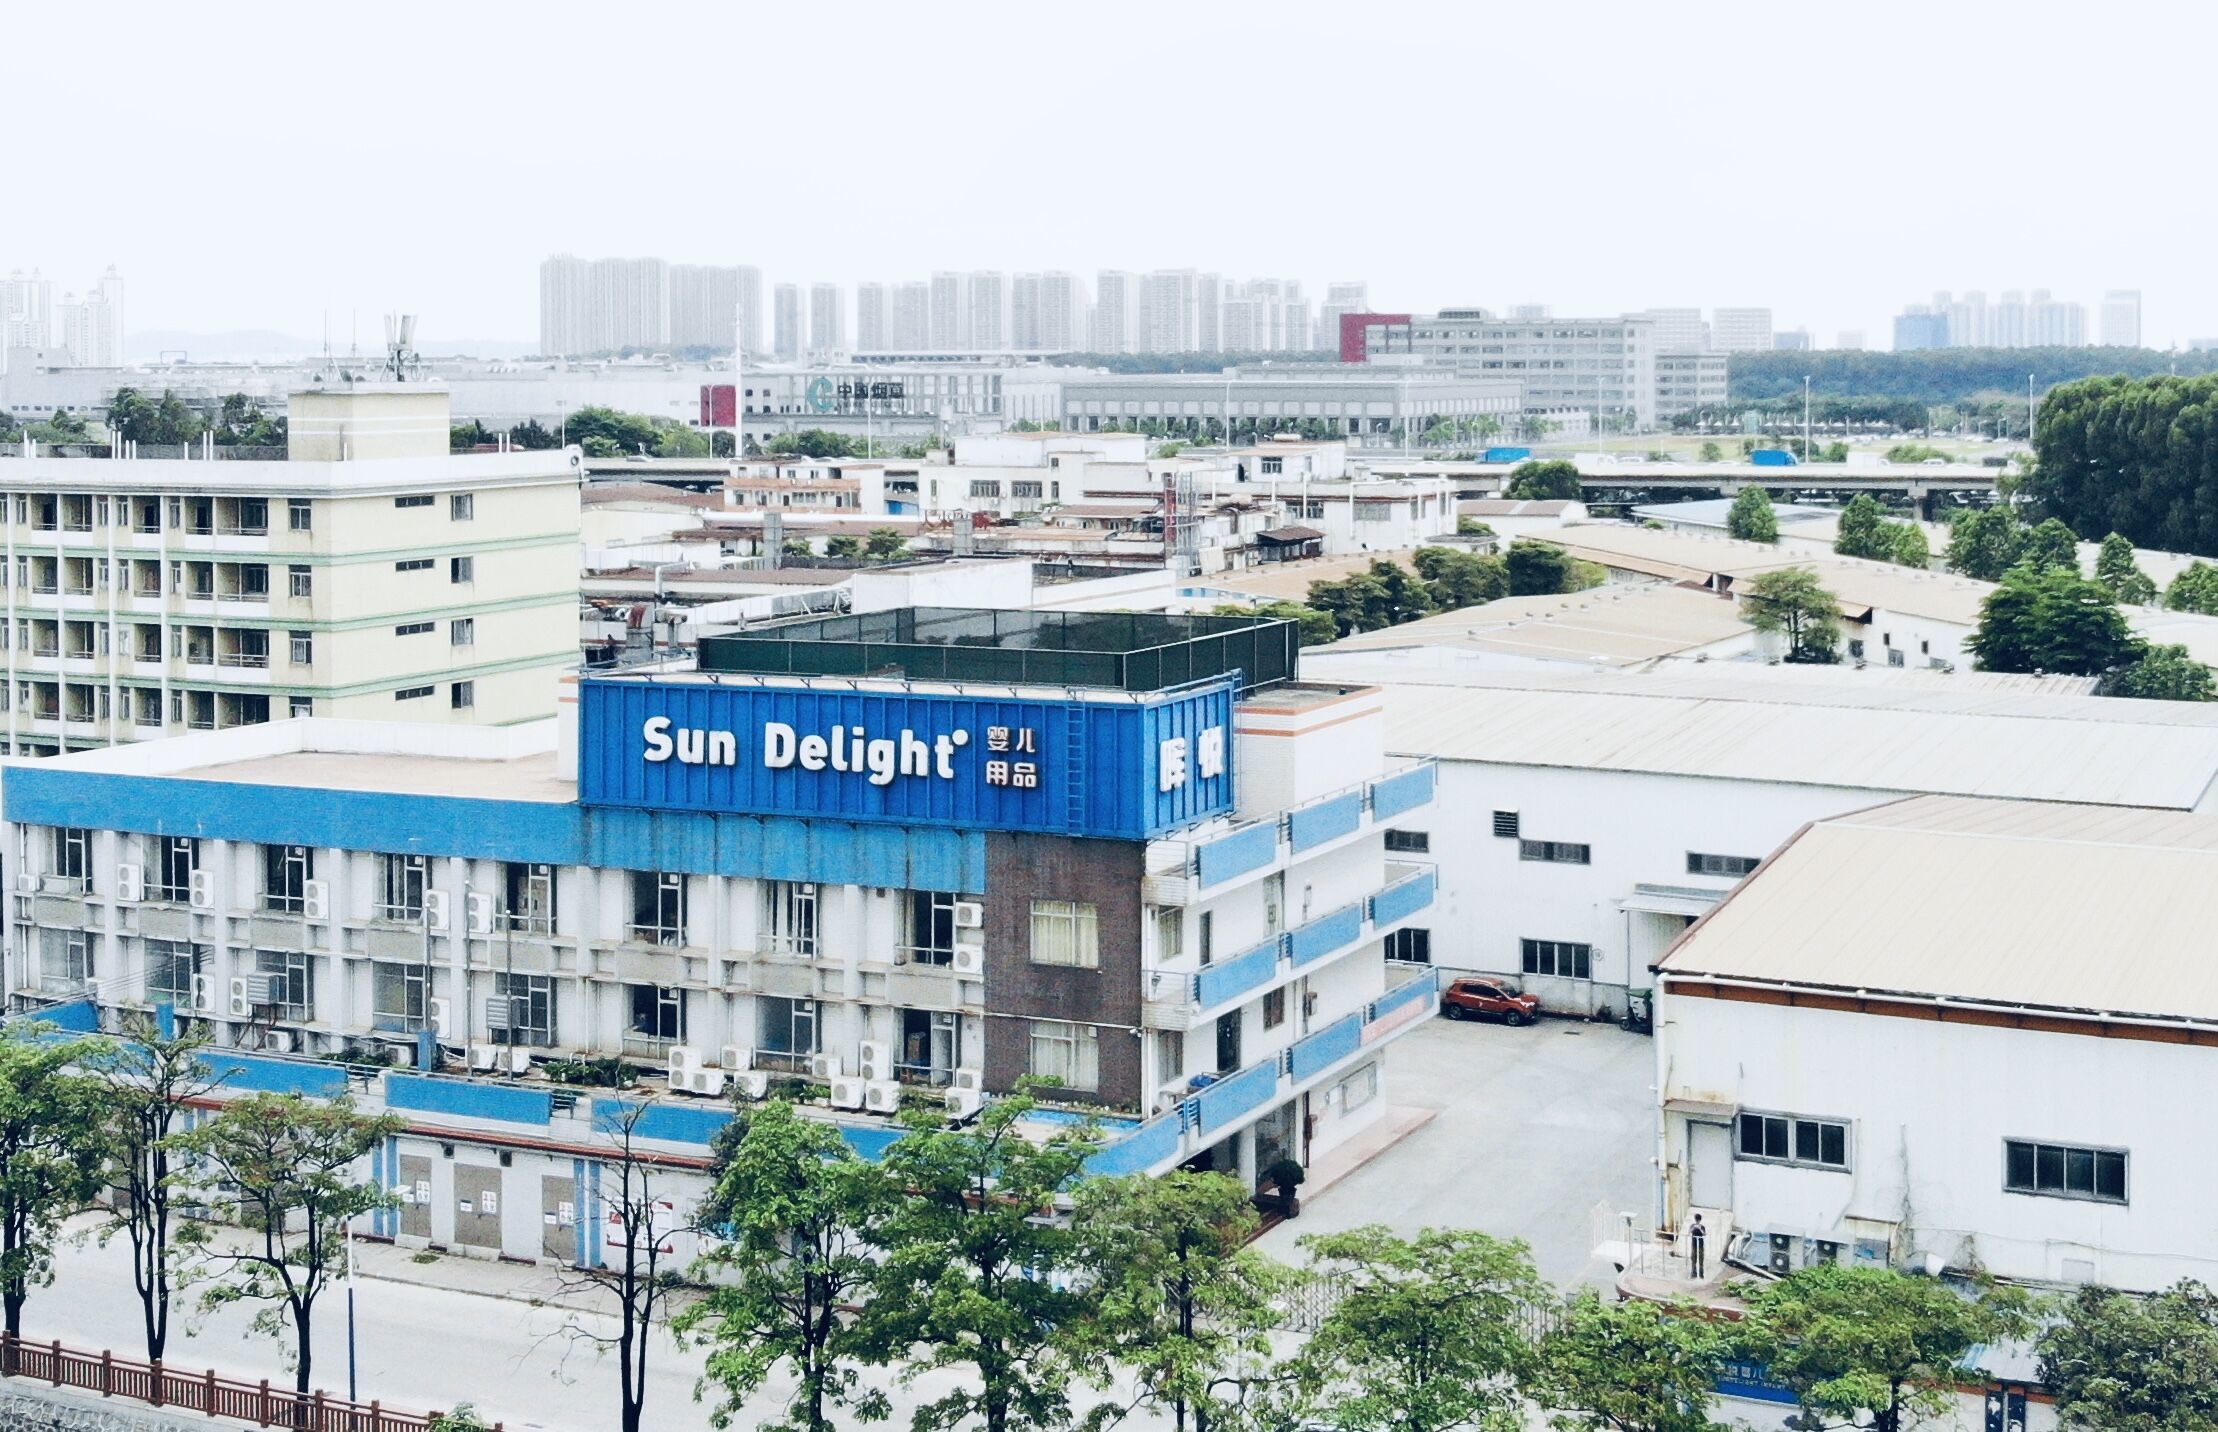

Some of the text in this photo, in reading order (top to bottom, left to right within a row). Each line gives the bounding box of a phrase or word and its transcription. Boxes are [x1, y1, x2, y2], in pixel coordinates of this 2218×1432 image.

[643, 716, 954, 786] Sun Delight
[987, 726, 1036, 753] 婴儿
[986, 760, 1037, 788] 用品
